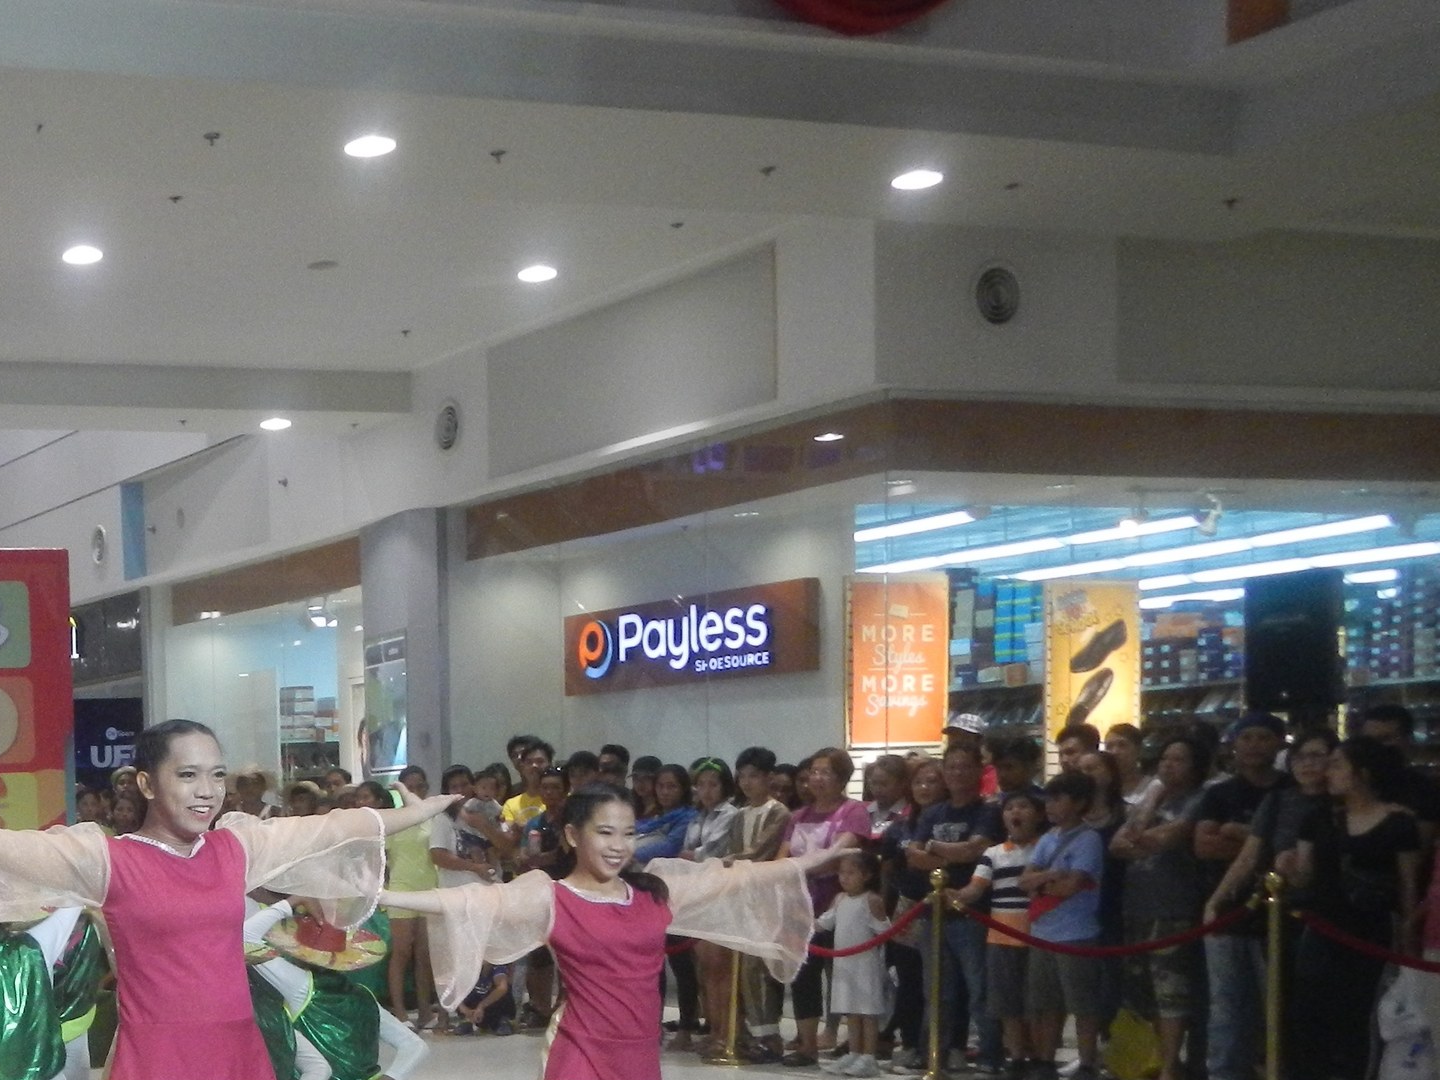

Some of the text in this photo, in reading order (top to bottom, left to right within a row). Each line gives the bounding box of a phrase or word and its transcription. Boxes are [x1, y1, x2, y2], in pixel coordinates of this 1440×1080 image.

[617, 603, 770, 670] Payless
[861, 623, 935, 643] MORE
[871, 642, 927, 674] Styles
[861, 673, 935, 692] MORE
[864, 693, 929, 718] Savings
[90, 744, 137, 769] UF
